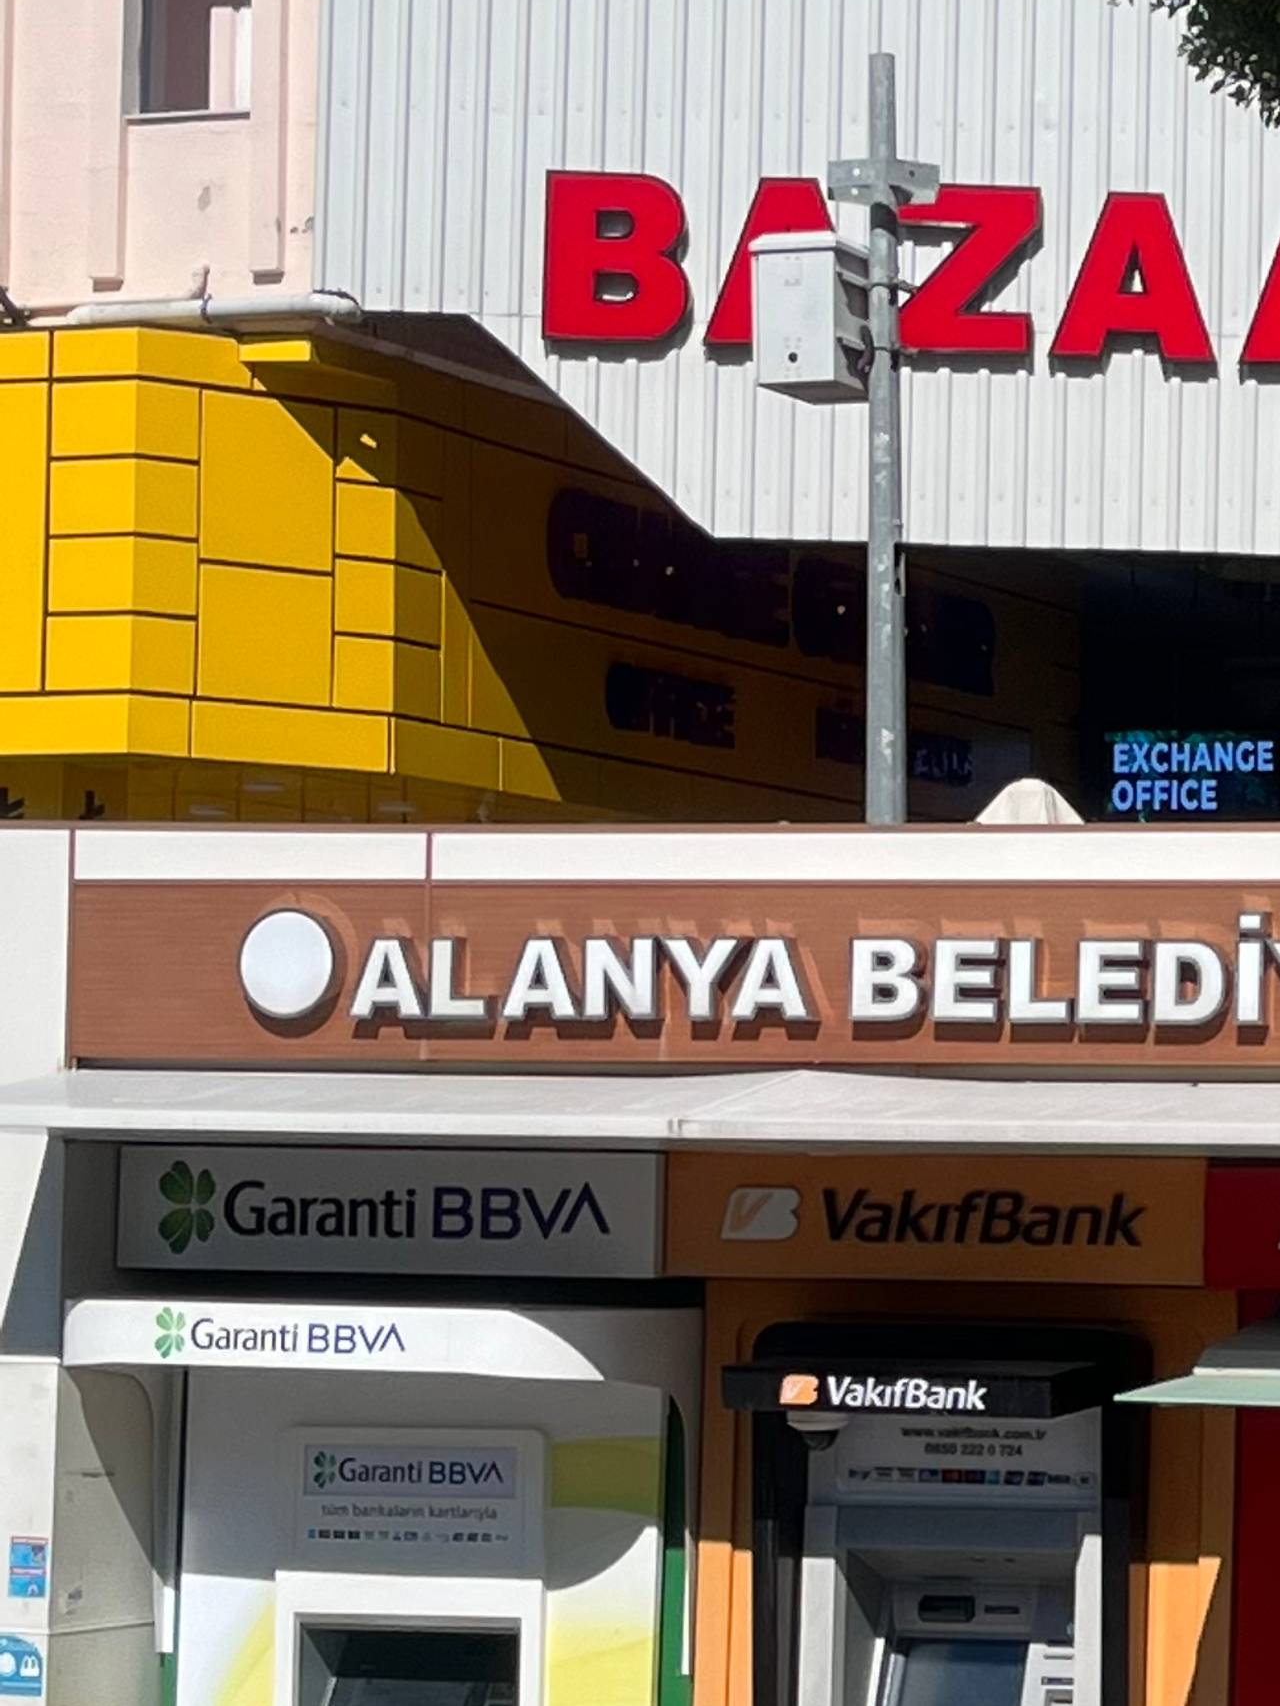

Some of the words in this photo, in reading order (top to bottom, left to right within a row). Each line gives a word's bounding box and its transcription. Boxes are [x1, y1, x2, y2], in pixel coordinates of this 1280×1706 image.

[1113, 740, 1274, 773] EXCHANGE
[1112, 779, 1217, 811] OFFICE
[349, 935, 807, 1021] ALANYA
[223, 1180, 416, 1238] Garanti
[432, 1182, 611, 1239] BBVA
[190, 1317, 299, 1353] Garanti
[307, 1322, 406, 1354] BBVA
[960, 1444, 984, 1456] 222
[1000, 1445, 1023, 1457] 724
[338, 1457, 423, 1485] Garanti
[429, 1460, 504, 1485] BBVA
